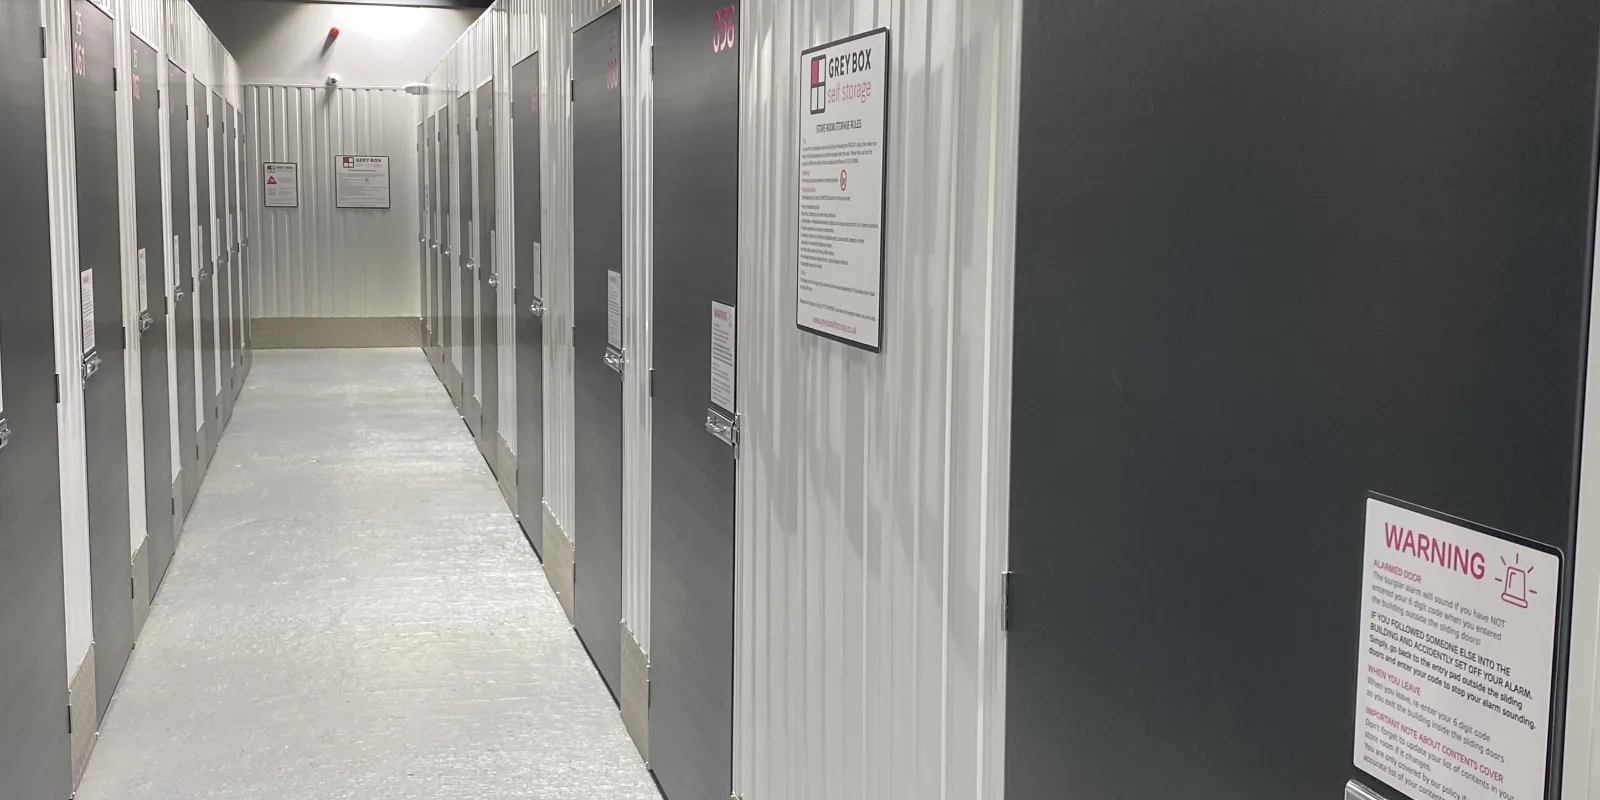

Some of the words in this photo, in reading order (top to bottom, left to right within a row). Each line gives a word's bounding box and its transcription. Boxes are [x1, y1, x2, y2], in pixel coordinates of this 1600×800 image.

[827, 82, 841, 103] self
[842, 81, 872, 103] storage
[828, 53, 850, 78] GREY
[852, 48, 872, 73] BOX
[1373, 558, 1402, 576] ALARMED
[1403, 570, 1421, 584] DOOR
[1385, 522, 1485, 579] WARNING
[1371, 595, 1380, 605] the
[1381, 599, 1404, 616] building
[1405, 609, 1427, 624] outside
[1428, 618, 1438, 629] the
[1439, 622, 1459, 639] sliding
[1460, 631, 1481, 646] doors!
[1372, 570, 1383, 582] The
[1384, 575, 1404, 591] burglar
[1405, 583, 1421, 596] alarm
[1423, 590, 1432, 601] will
[1434, 594, 1452, 609] sound
[1454, 601, 1458, 611] if
[1460, 605, 1471, 617] you
[1473, 609, 1488, 622] have
[1490, 615, 1505, 629] NOT
[1372, 583, 1393, 598] entered
[1394, 593, 1406, 605] your
[1408, 597, 1412, 605] 6
[1413, 599, 1426, 613] digit
[1428, 605, 1442, 618] code
[1444, 611, 1461, 625] when
[1462, 620, 1474, 632] you
[1475, 624, 1501, 641] entered
[1369, 634, 1388, 651] Simply,
[1389, 645, 1396, 654] go
[1397, 646, 1411, 660] back
[1413, 654, 1419, 663] to
[1420, 657, 1430, 668] the
[1431, 662, 1447, 677] entry
[1449, 669, 1460, 683] pad
[1462, 675, 1485, 693] outside
[1487, 685, 1498, 698] the
[1500, 691, 1522, 710] sliding
[1370, 622, 1398, 641] BUILDING
[1399, 634, 1412, 648] AND
[1414, 641, 1453, 665] ACCIDENTLY
[1454, 658, 1467, 671] SET
[1468, 664, 1481, 678] OFF
[1483, 670, 1503, 687] YOUR
[1504, 679, 1532, 700] ALARM.
[1371, 610, 1376, 620] IF
[1377, 613, 1389, 625] YOU
[1391, 619, 1424, 640] FOLLOWED
[1425, 633, 1458, 654] SOMEONE
[1460, 647, 1476, 662] ELSE
[1477, 655, 1494, 670] INTO
[1496, 662, 1510, 677] THE
[1367, 676, 1383, 690] When
[1384, 685, 1394, 697] you
[1395, 689, 1411, 705] leave,
[1413, 699, 1436, 716] re-enter
[1438, 711, 1451, 725] your
[1452, 717, 1457, 726] 6
[1458, 720, 1472, 735] digit
[1474, 728, 1490, 743] code
[1368, 664, 1386, 679] WHEN
[1387, 673, 1400, 686] YOU
[1401, 679, 1420, 696] LEAVE
[1368, 647, 1384, 660] doors
[1385, 654, 1395, 665] and
[1397, 660, 1411, 673] enter
[1412, 668, 1426, 680] your
[1427, 673, 1442, 686] code
[1443, 680, 1450, 690] to
[1451, 684, 1465, 699] stop
[1466, 692, 1480, 705] your
[1482, 697, 1500, 713] alarm
[1502, 707, 1536, 731] sounding.
[1364, 730, 1378, 743] store
[1379, 738, 1393, 751] room
[1394, 745, 1398, 754] if
[1399, 748, 1404, 757] it
[1405, 751, 1431, 774] changes.
[1365, 706, 1399, 730] IMPORTANT
[1400, 723, 1417, 739] NOTE
[1418, 733, 1440, 751] ABOUT
[1441, 744, 1477, 770] CONTENTS
[1479, 763, 1503, 783] COVER
[1366, 689, 1372, 698] as
[1374, 693, 1384, 705] you
[1385, 697, 1395, 709] exit
[1396, 703, 1406, 714] the
[1407, 708, 1430, 728] building
[1432, 720, 1450, 736] inside
[1451, 730, 1461, 742] the
[1462, 735, 1484, 754] sliding
[1485, 746, 1504, 763] doors
[1363, 753, 1386, 772] accurate
[1388, 766, 1396, 777] list
[1397, 771, 1403, 781] of
[1404, 777, 1417, 791] your
[1364, 741, 1374, 754] You
[1375, 749, 1384, 759] are
[1385, 753, 1397, 767] only
[1398, 760, 1421, 779] covered
[1422, 773, 1429, 785] by
[1430, 779, 1440, 790] our
[1442, 783, 1460, 800] policy
[1365, 718, 1379, 732] Don't
[1380, 725, 1398, 743] forget
[1399, 736, 1404, 745] to
[1406, 739, 1426, 758] update
[1428, 751, 1441, 765] your
[1442, 757, 1451, 770] list
[1453, 763, 1459, 774] of
[1461, 768, 1489, 790] contents
[1490, 782, 1497, 794] in
[1498, 788, 1514, 800] your
